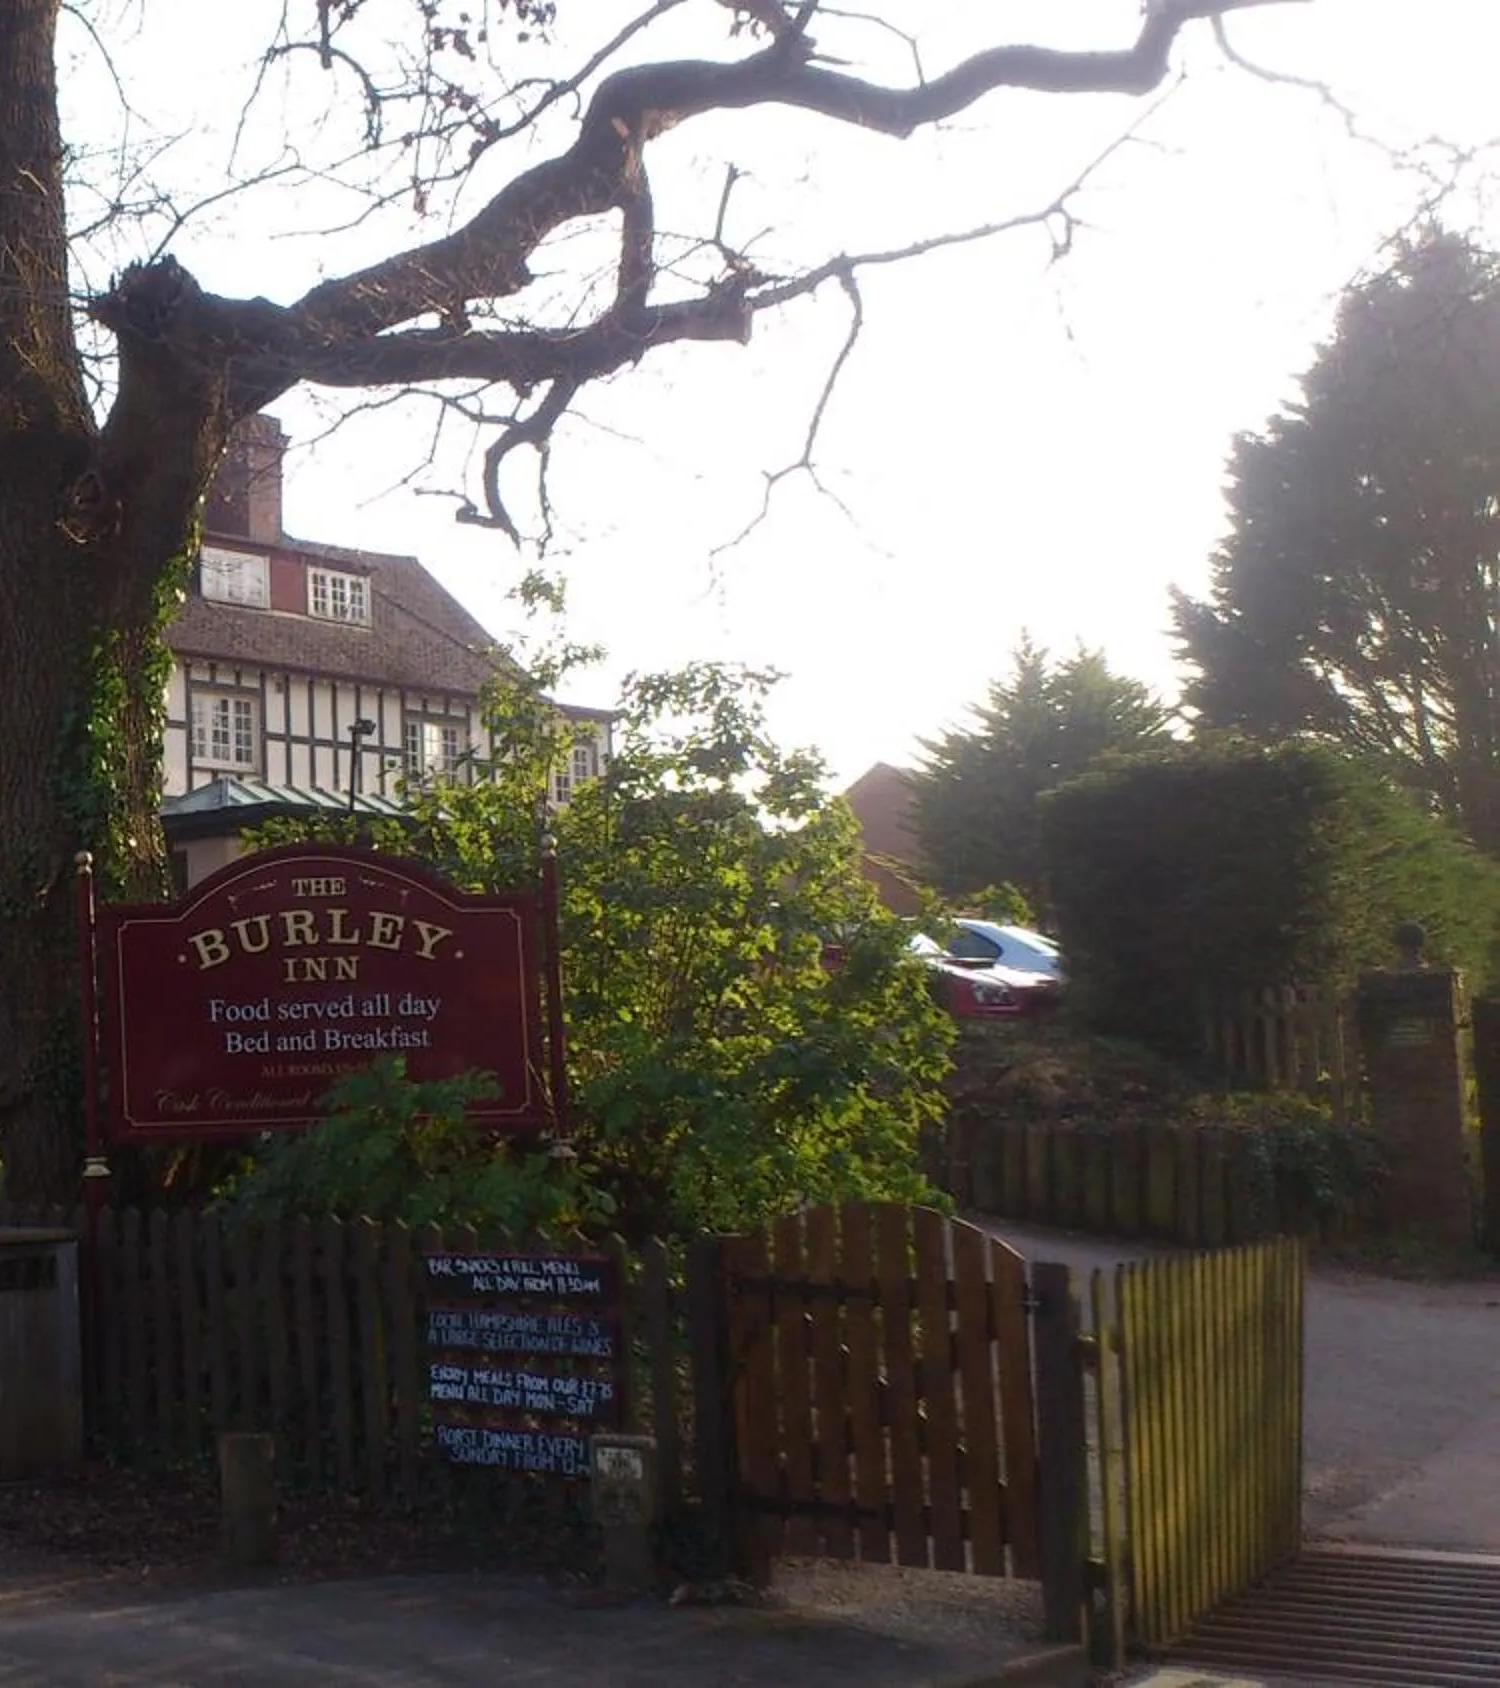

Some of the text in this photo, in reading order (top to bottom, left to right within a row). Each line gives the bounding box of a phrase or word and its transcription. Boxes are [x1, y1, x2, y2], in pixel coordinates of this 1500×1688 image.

[291, 877, 347, 897] THE
[188, 907, 453, 970] BURLEY
[282, 956, 360, 983] INN
[210, 991, 441, 1022] Food served all day
[226, 1025, 431, 1053] Bed and Breakfast
[472, 1276, 494, 1292] ALL
[497, 1276, 520, 1292] DAY
[523, 1277, 552, 1292] FROM
[428, 1328, 437, 1346] A
[430, 1365, 467, 1385] ENJOY
[473, 1369, 512, 1388] MEALS
[516, 1372, 549, 1393] FROM
[553, 1376, 579, 1397] OUR
[430, 1383, 463, 1400] MENU
[467, 1383, 489, 1402] ALL
[492, 1388, 521, 1407] DAY
[437, 1425, 584, 1460] ROAST DINNER EVERY
[449, 1446, 508, 1466] SUNDAY
[514, 1450, 555, 1472] FROM
